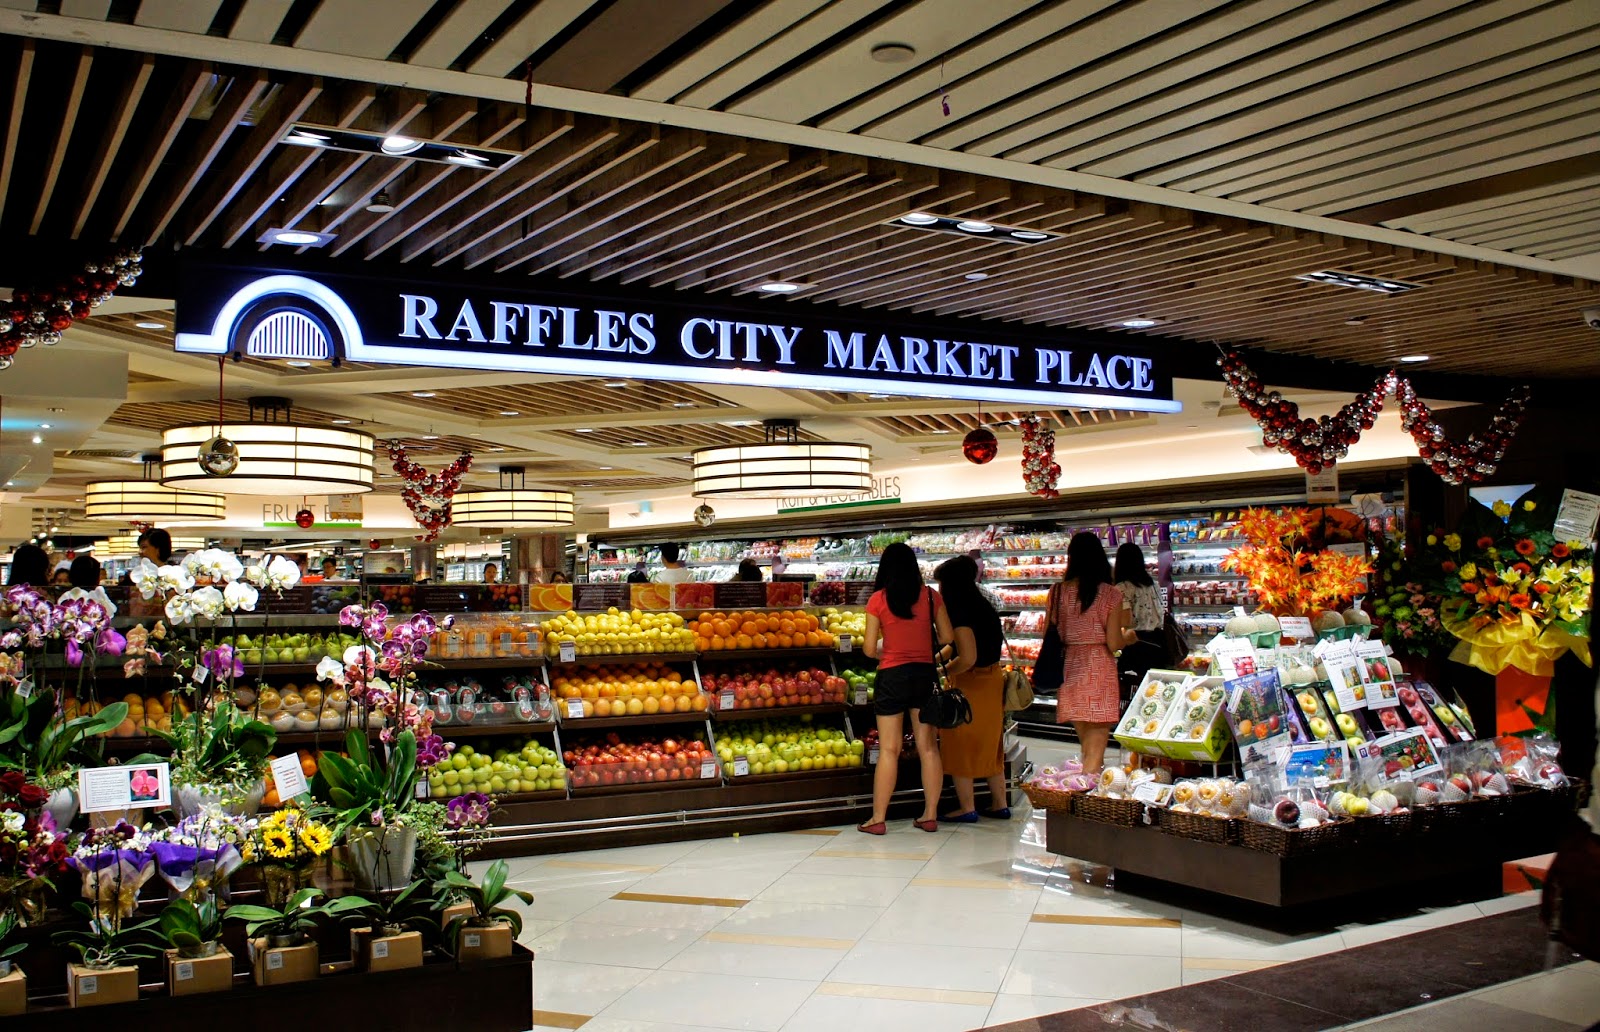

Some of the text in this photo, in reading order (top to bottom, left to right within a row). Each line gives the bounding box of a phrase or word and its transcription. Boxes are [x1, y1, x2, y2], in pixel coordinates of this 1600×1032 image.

[398, 293, 1154, 391] RAFFLES CITY MARKET PLACE
